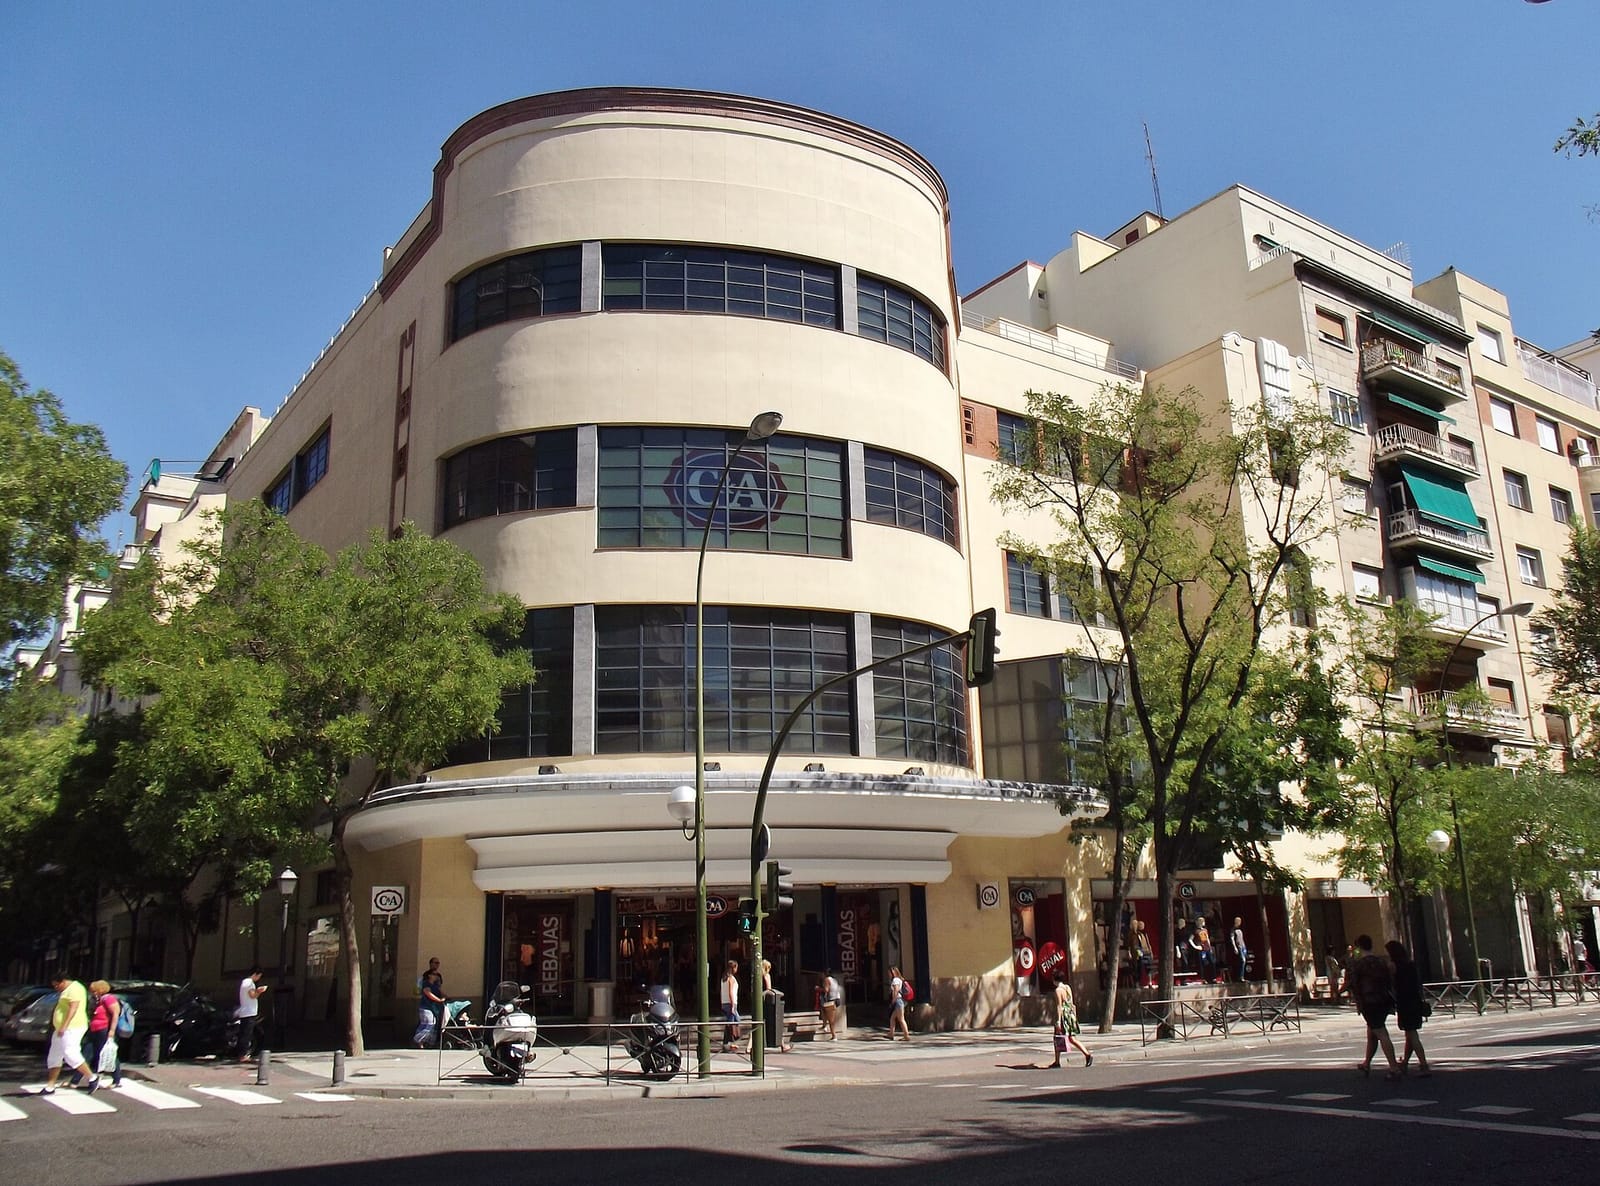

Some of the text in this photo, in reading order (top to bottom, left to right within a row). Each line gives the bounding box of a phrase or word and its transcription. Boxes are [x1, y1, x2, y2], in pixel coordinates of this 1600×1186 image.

[542, 916, 560, 993] REBAJAS
[840, 909, 856, 983] REBAJAS
[1041, 951, 1064, 974] FINAL
